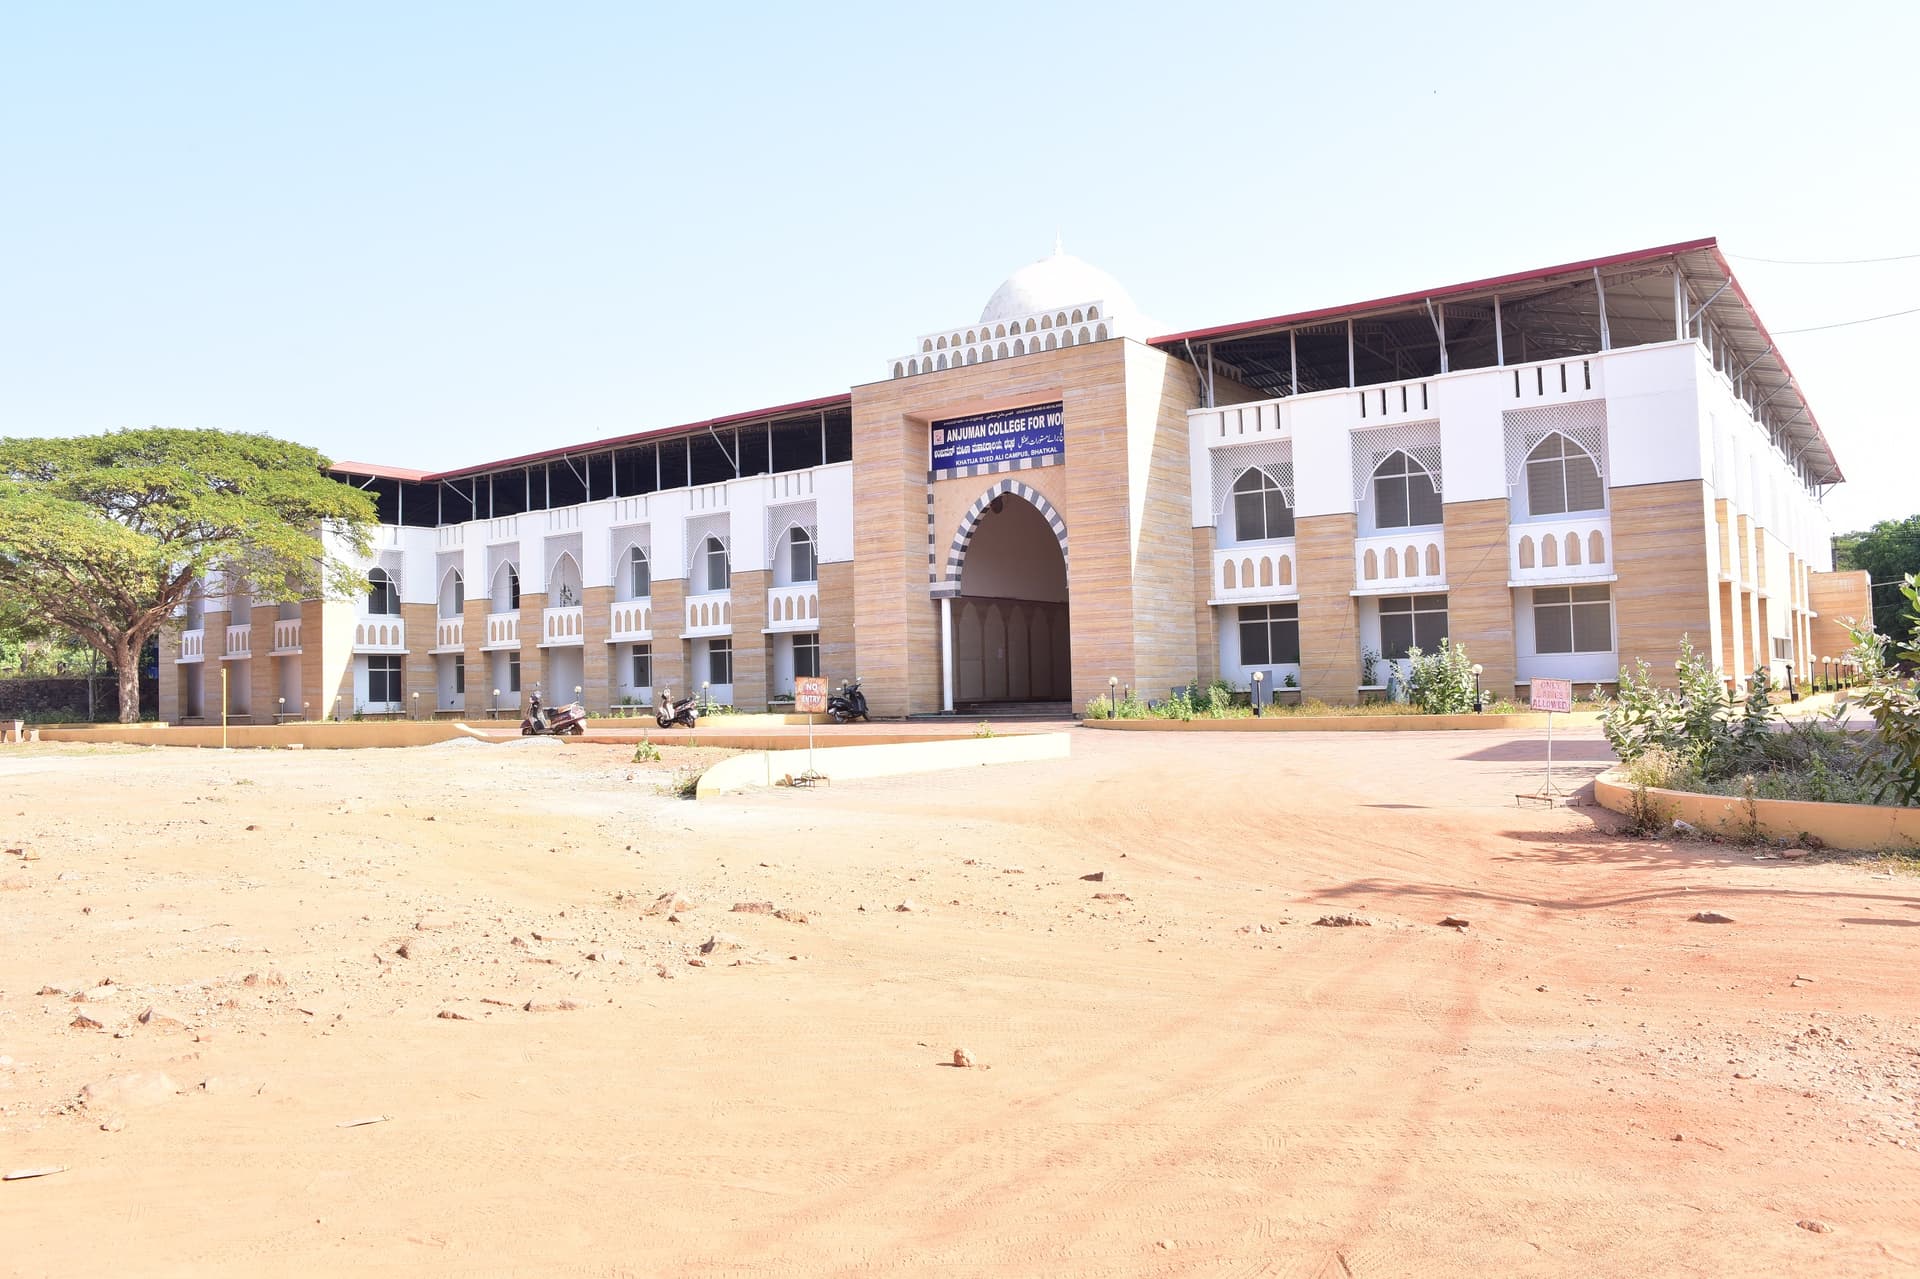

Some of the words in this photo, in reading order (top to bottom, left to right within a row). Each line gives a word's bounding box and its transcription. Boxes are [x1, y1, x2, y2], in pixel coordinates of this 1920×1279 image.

[947, 424, 985, 442] ANJUMAN
[988, 418, 1026, 436] COLLEGE
[1028, 415, 1045, 430] FOR
[955, 458, 978, 466] KHATIJA
[1031, 447, 1057, 456] BHATKAL
[806, 683, 818, 691] NO
[801, 695, 821, 703] ENTRY
